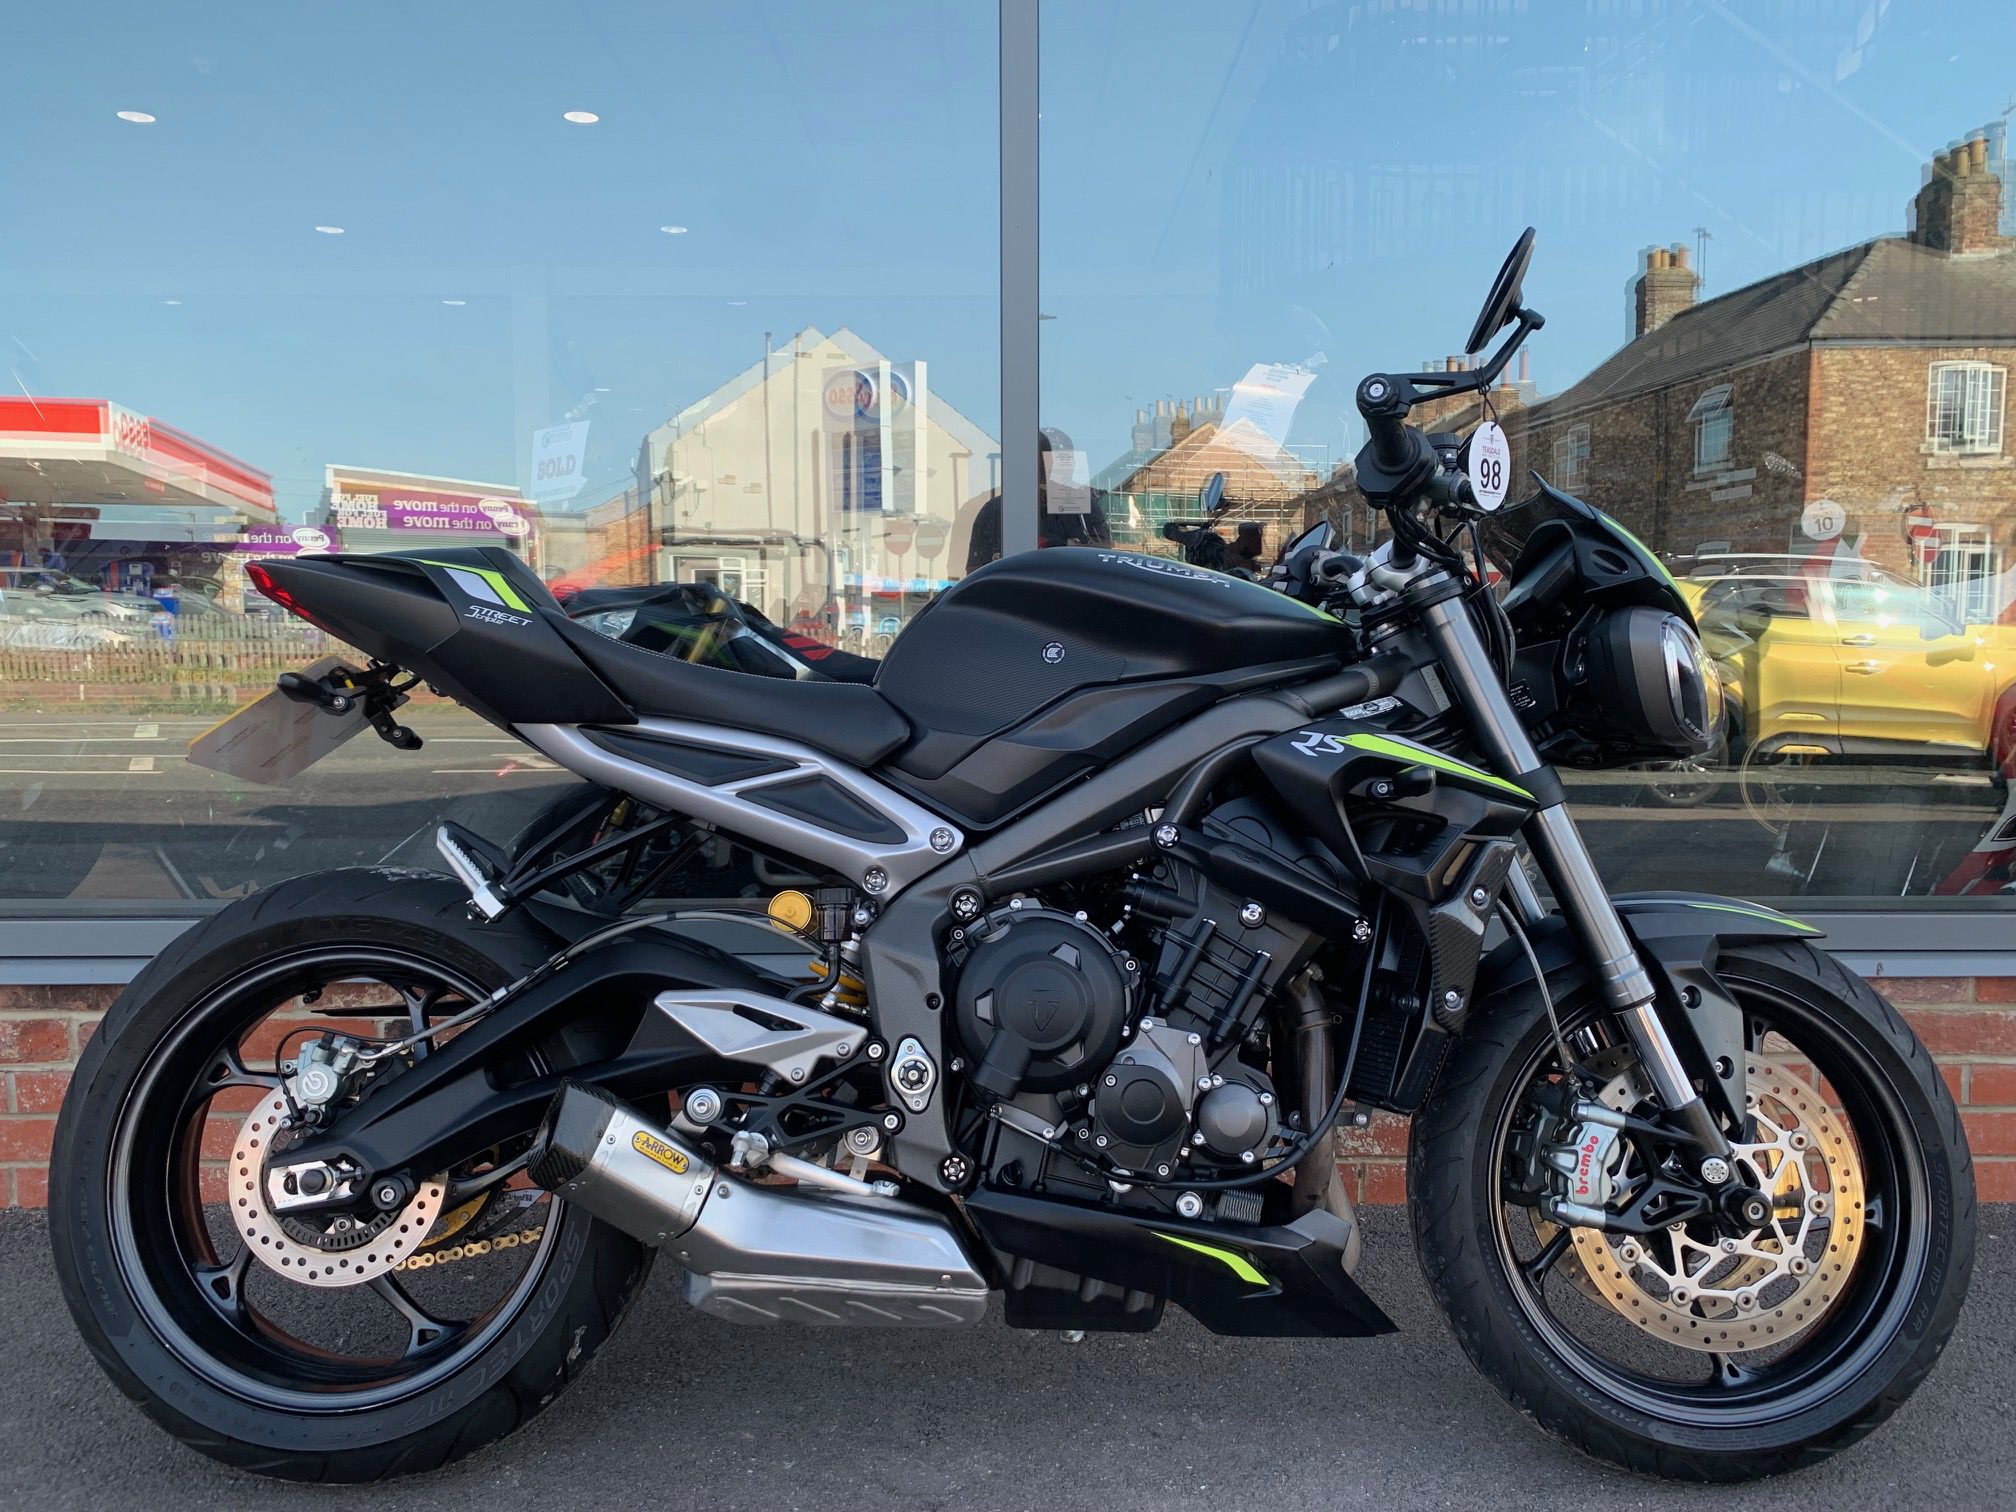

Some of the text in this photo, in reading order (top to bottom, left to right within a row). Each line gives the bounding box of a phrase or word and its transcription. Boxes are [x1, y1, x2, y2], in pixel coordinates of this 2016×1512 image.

[537, 454, 577, 481] SOLD
[1480, 458, 1501, 490] 98
[1814, 516, 1834, 532] 10
[1098, 554, 1231, 588] TRIUMPH
[464, 605, 533, 626] STREET
[1290, 731, 1352, 757] RS
[641, 1137, 684, 1165] ARROW
[1575, 1135, 1599, 1195] brembo
[466, 1220, 581, 1394] SPORTEC
